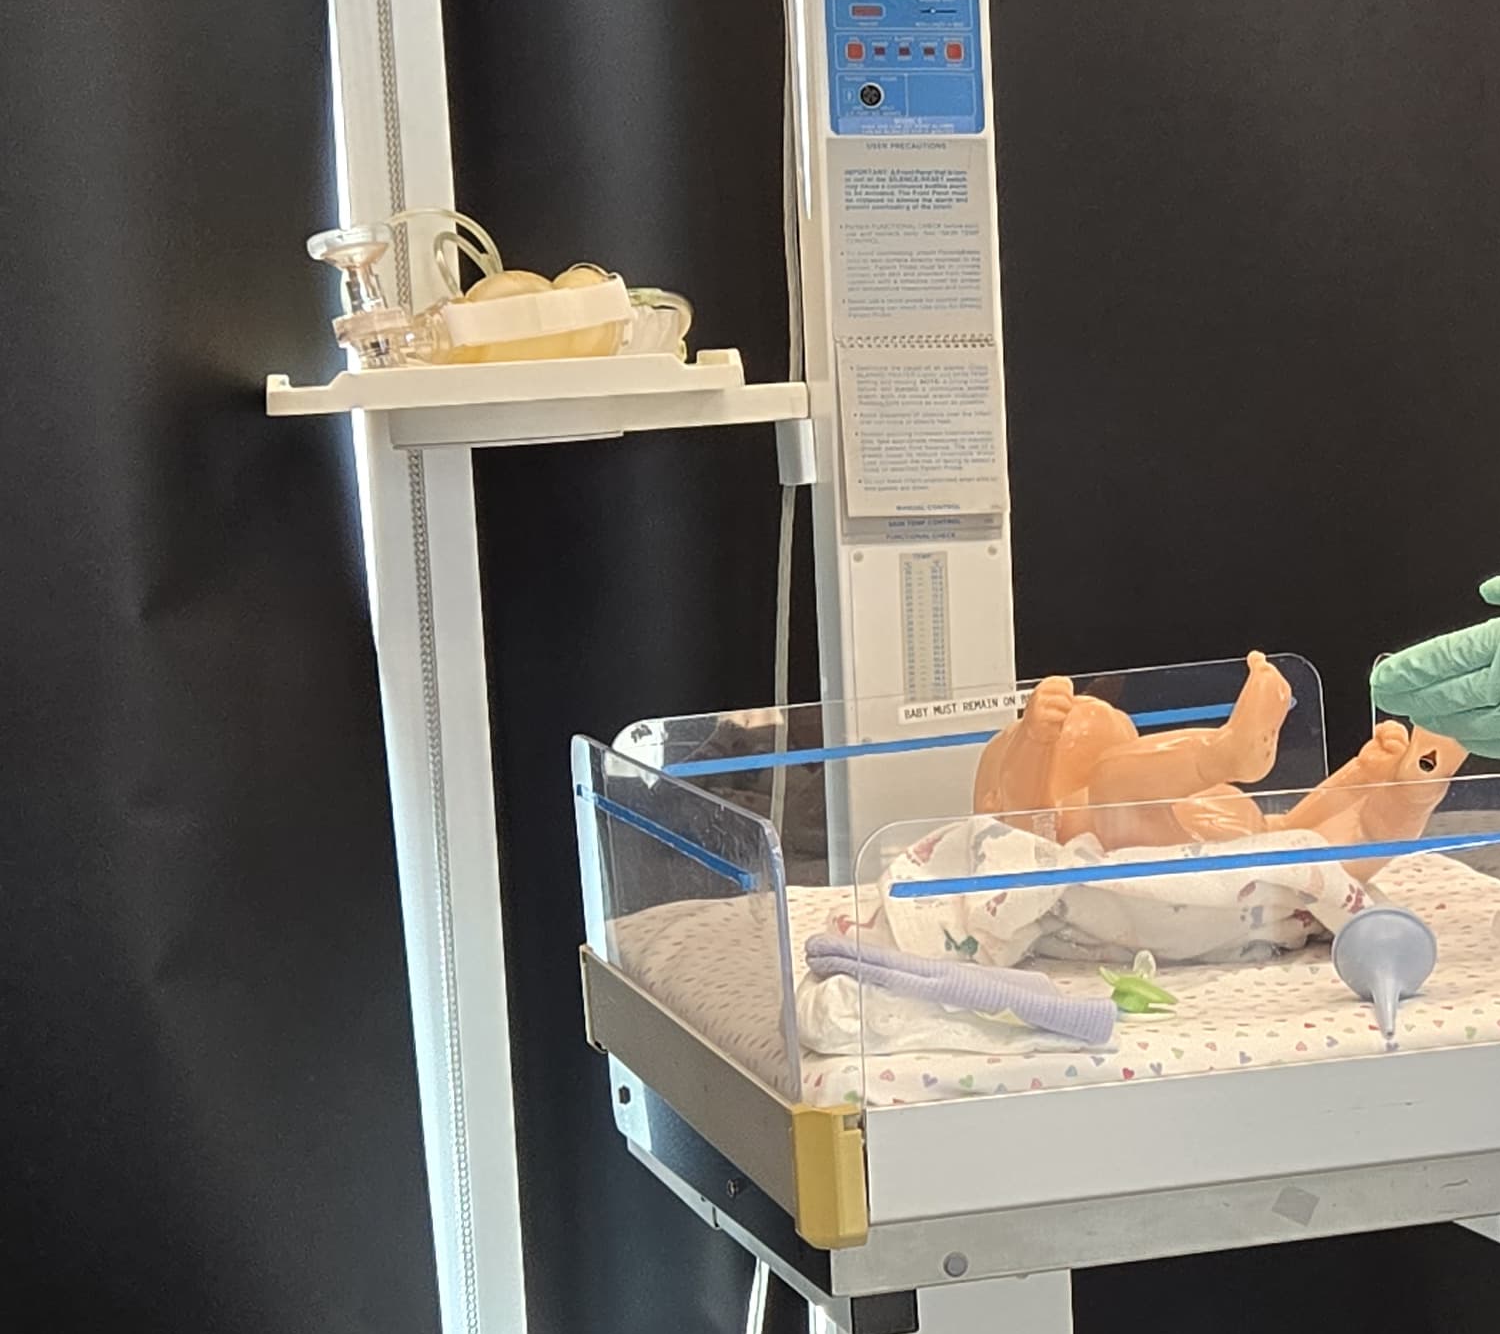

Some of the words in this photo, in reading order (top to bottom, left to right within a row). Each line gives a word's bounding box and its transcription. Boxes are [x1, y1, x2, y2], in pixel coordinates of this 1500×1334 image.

[904, 707, 928, 720] BABY
[933, 702, 957, 715] MUST
[962, 698, 999, 712] REMAIN
[1003, 695, 1016, 706] ON
